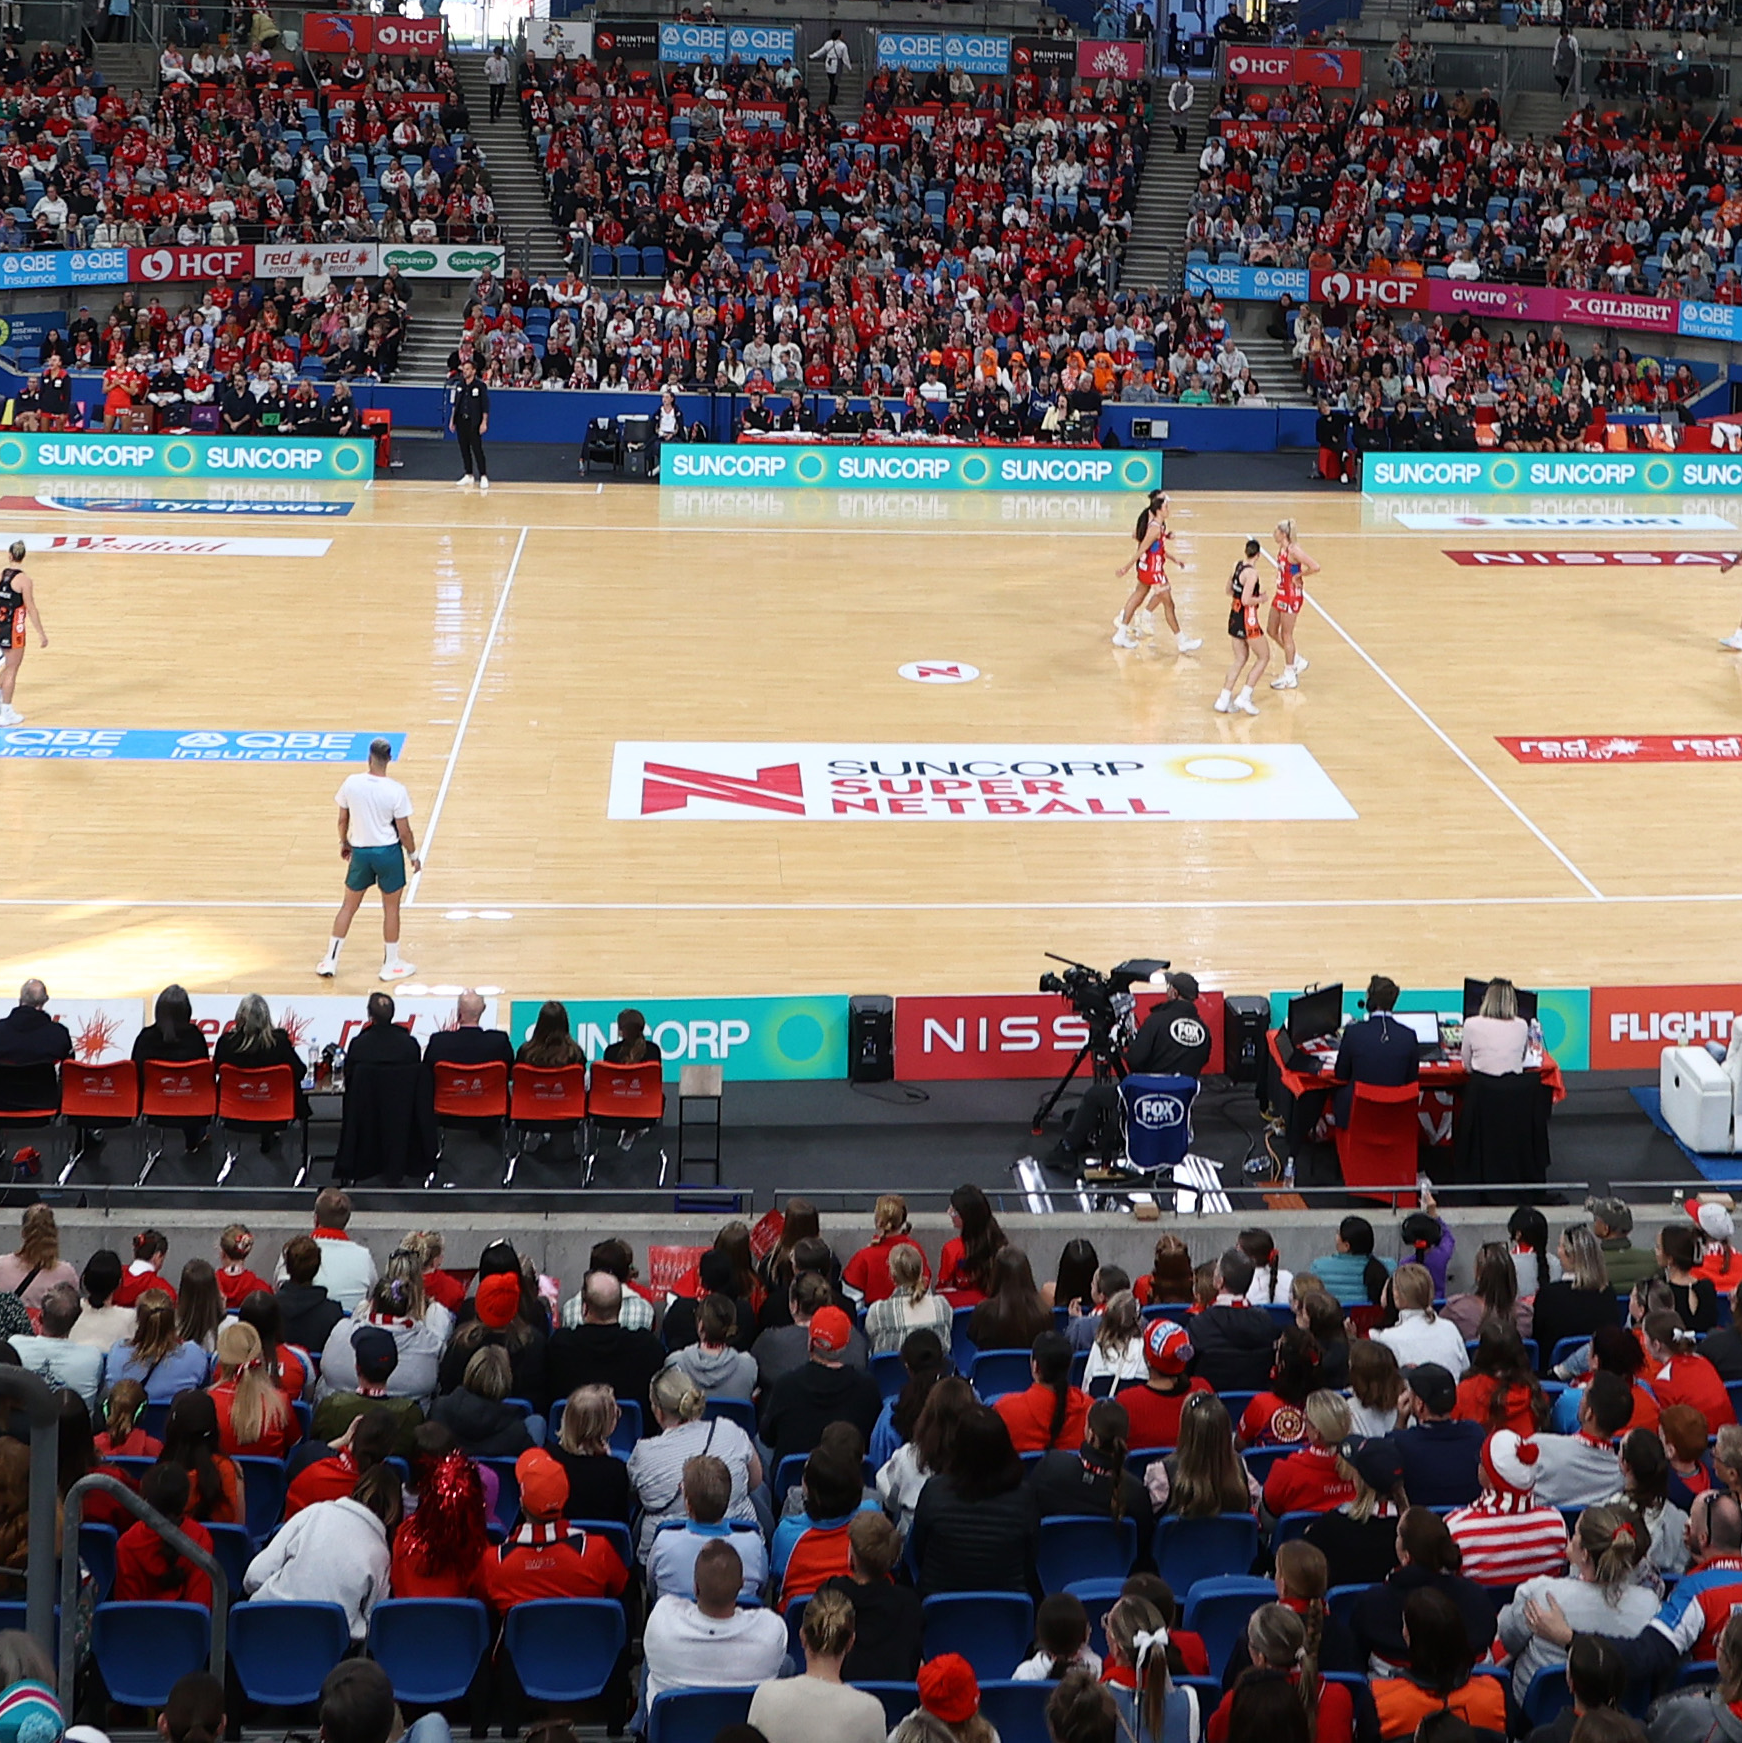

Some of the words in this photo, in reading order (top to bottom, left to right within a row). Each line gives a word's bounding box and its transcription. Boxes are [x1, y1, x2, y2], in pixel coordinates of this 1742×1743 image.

[401, 29, 438, 45] HCF
[616, 35, 656, 44] PRINTHIE
[683, 29, 725, 48] QBE
[751, 30, 793, 50] QBE
[899, 38, 941, 55] QBE
[966, 39, 1008, 58] QBE
[1033, 51, 1073, 60] PRINTHIE
[1251, 59, 1288, 74] HCF
[21, 255, 56, 272] QBE
[93, 252, 123, 269] QBE
[180, 252, 242, 276] HCF
[263, 250, 292, 266] red
[323, 249, 350, 264] red
[1206, 268, 1240, 285] QBE
[1271, 271, 1306, 287] QBE
[1357, 279, 1417, 303] HCF
[1452, 288, 1506, 305] aware
[1587, 299, 1671, 322] GILBERT
[1700, 309, 1734, 326] QBE
[38, 444, 154, 467] SUNCORP
[206, 447, 323, 470] SUNCORP
[673, 455, 786, 477] SUNCORP
[838, 457, 950, 479] SUNCORP
[1001, 460, 1112, 482] SUNCORP
[1374, 463, 1481, 484] SUNCORP
[1530, 463, 1636, 484] SUNCORP
[152, 500, 341, 514] Tyrepower
[48, 537, 234, 553] Westfield
[5, 730, 126, 746] QBE
[236, 732, 356, 749] QBE
[1519, 740, 1588, 753] red
[1671, 737, 1740, 751] red
[170, 747, 347, 760] Insurance
[827, 760, 1144, 777] SUNCORP
[830, 779, 1070, 795] SUPER
[831, 798, 1171, 814] NETBALL
[1178, 1021, 1199, 1037] FOX
[1610, 1011, 1734, 1041] FLIGHT
[1141, 1099, 1174, 1117] FOX
